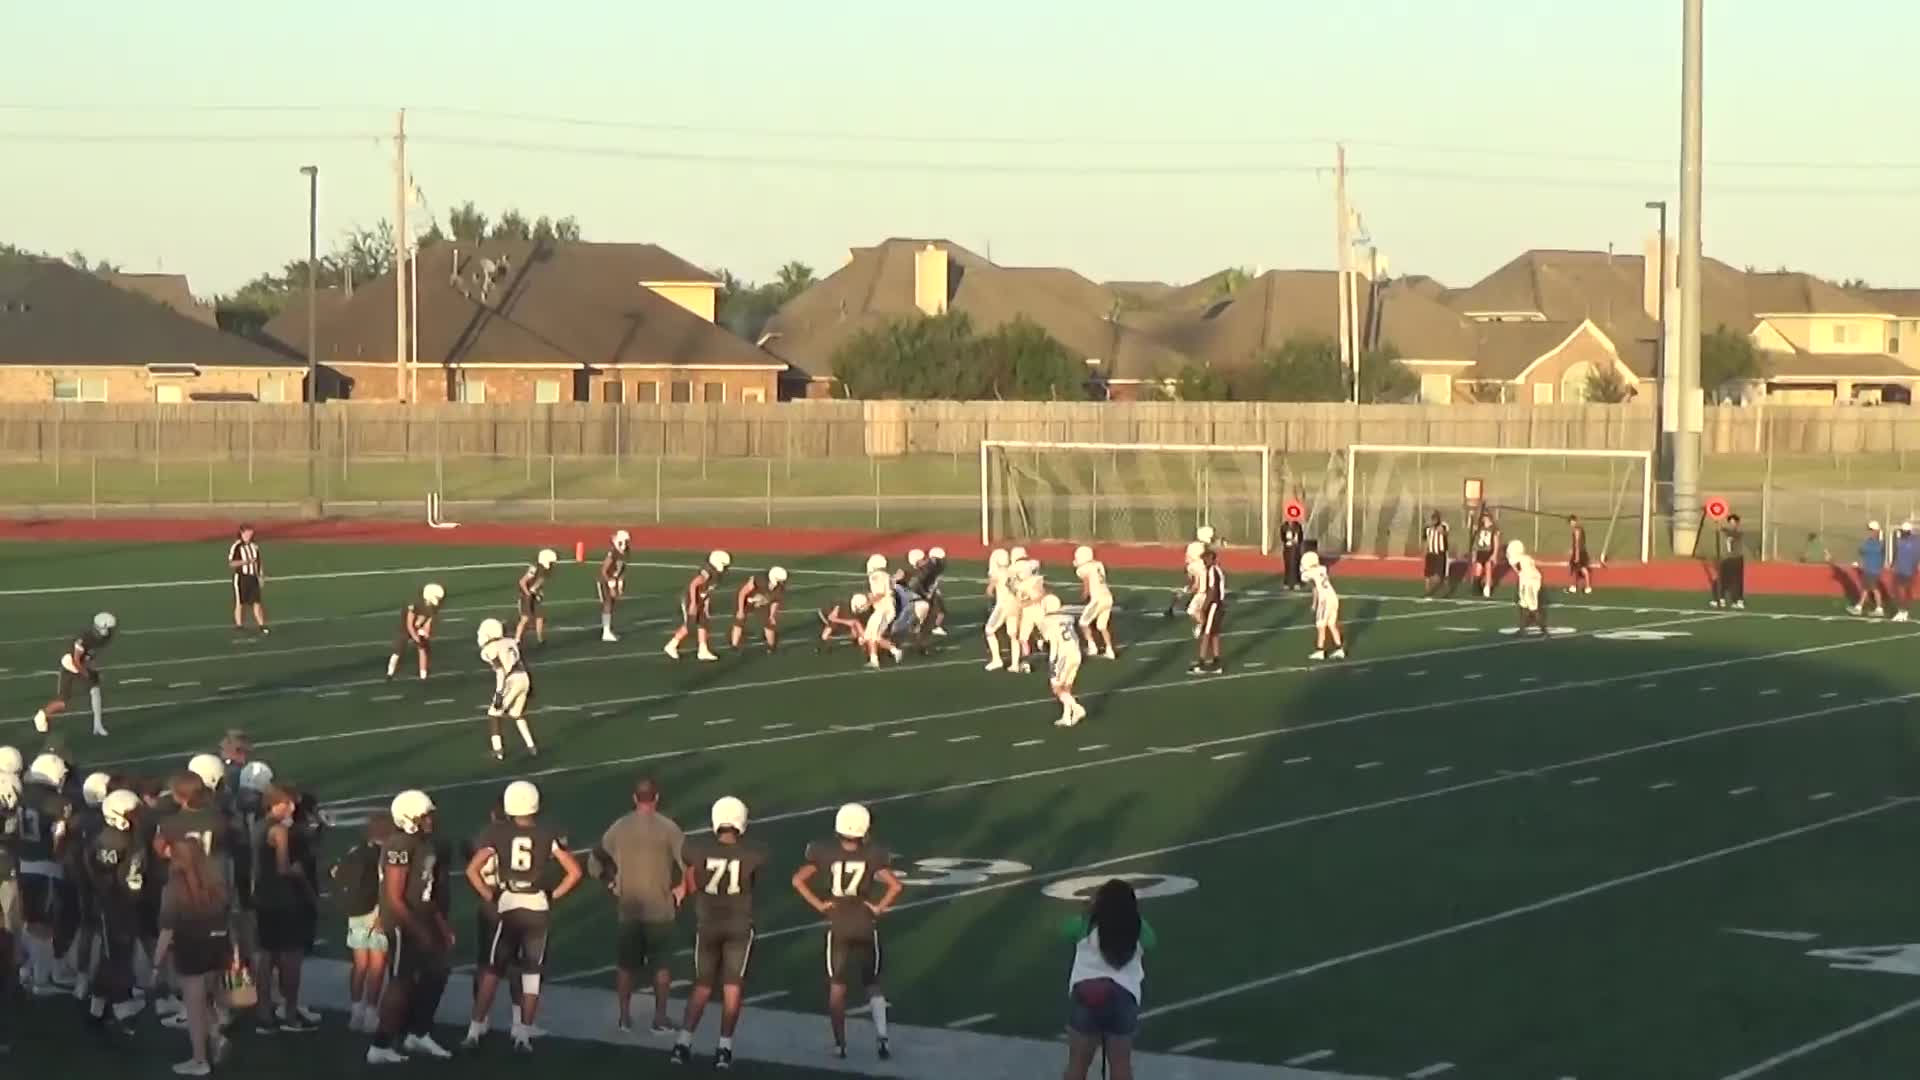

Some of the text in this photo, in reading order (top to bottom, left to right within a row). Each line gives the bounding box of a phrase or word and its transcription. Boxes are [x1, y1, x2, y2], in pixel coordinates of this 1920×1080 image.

[511, 836, 532, 871] 6
[705, 857, 741, 895] 71
[831, 861, 867, 897] 17
